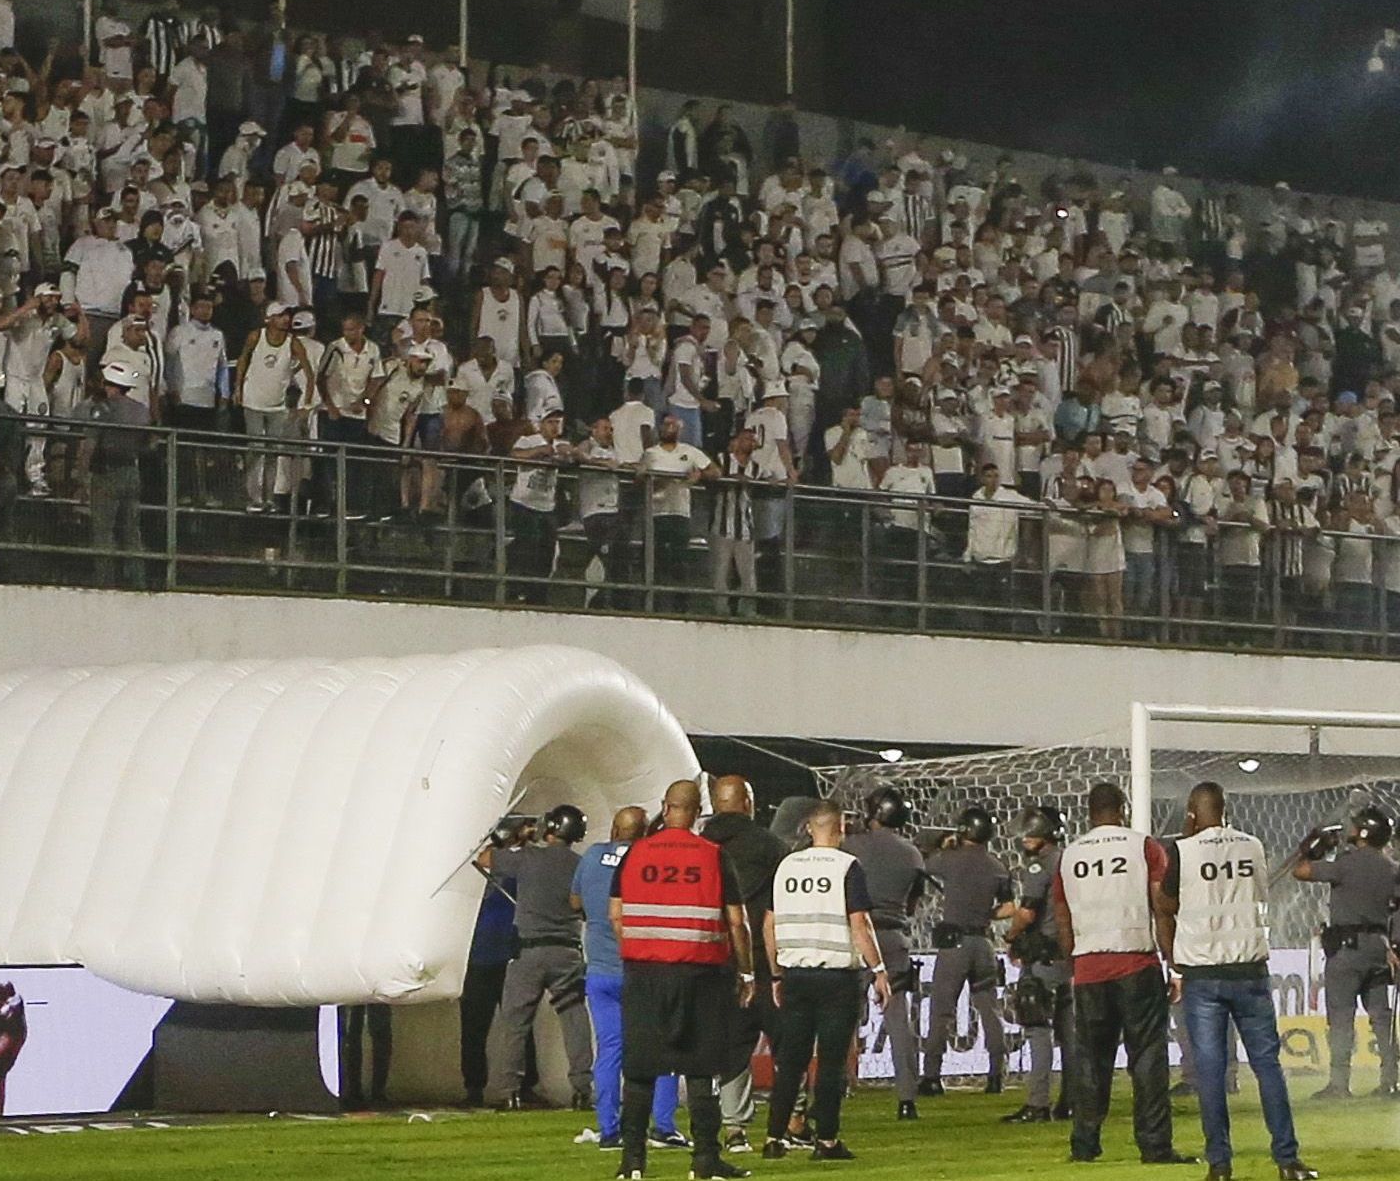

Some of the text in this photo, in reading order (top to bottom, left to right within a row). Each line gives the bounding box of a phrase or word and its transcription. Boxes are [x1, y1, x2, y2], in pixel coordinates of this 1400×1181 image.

[642, 865, 701, 884] 025
[1073, 856, 1128, 879] 012
[1200, 859, 1254, 881] 015
[785, 877, 832, 894] 009
